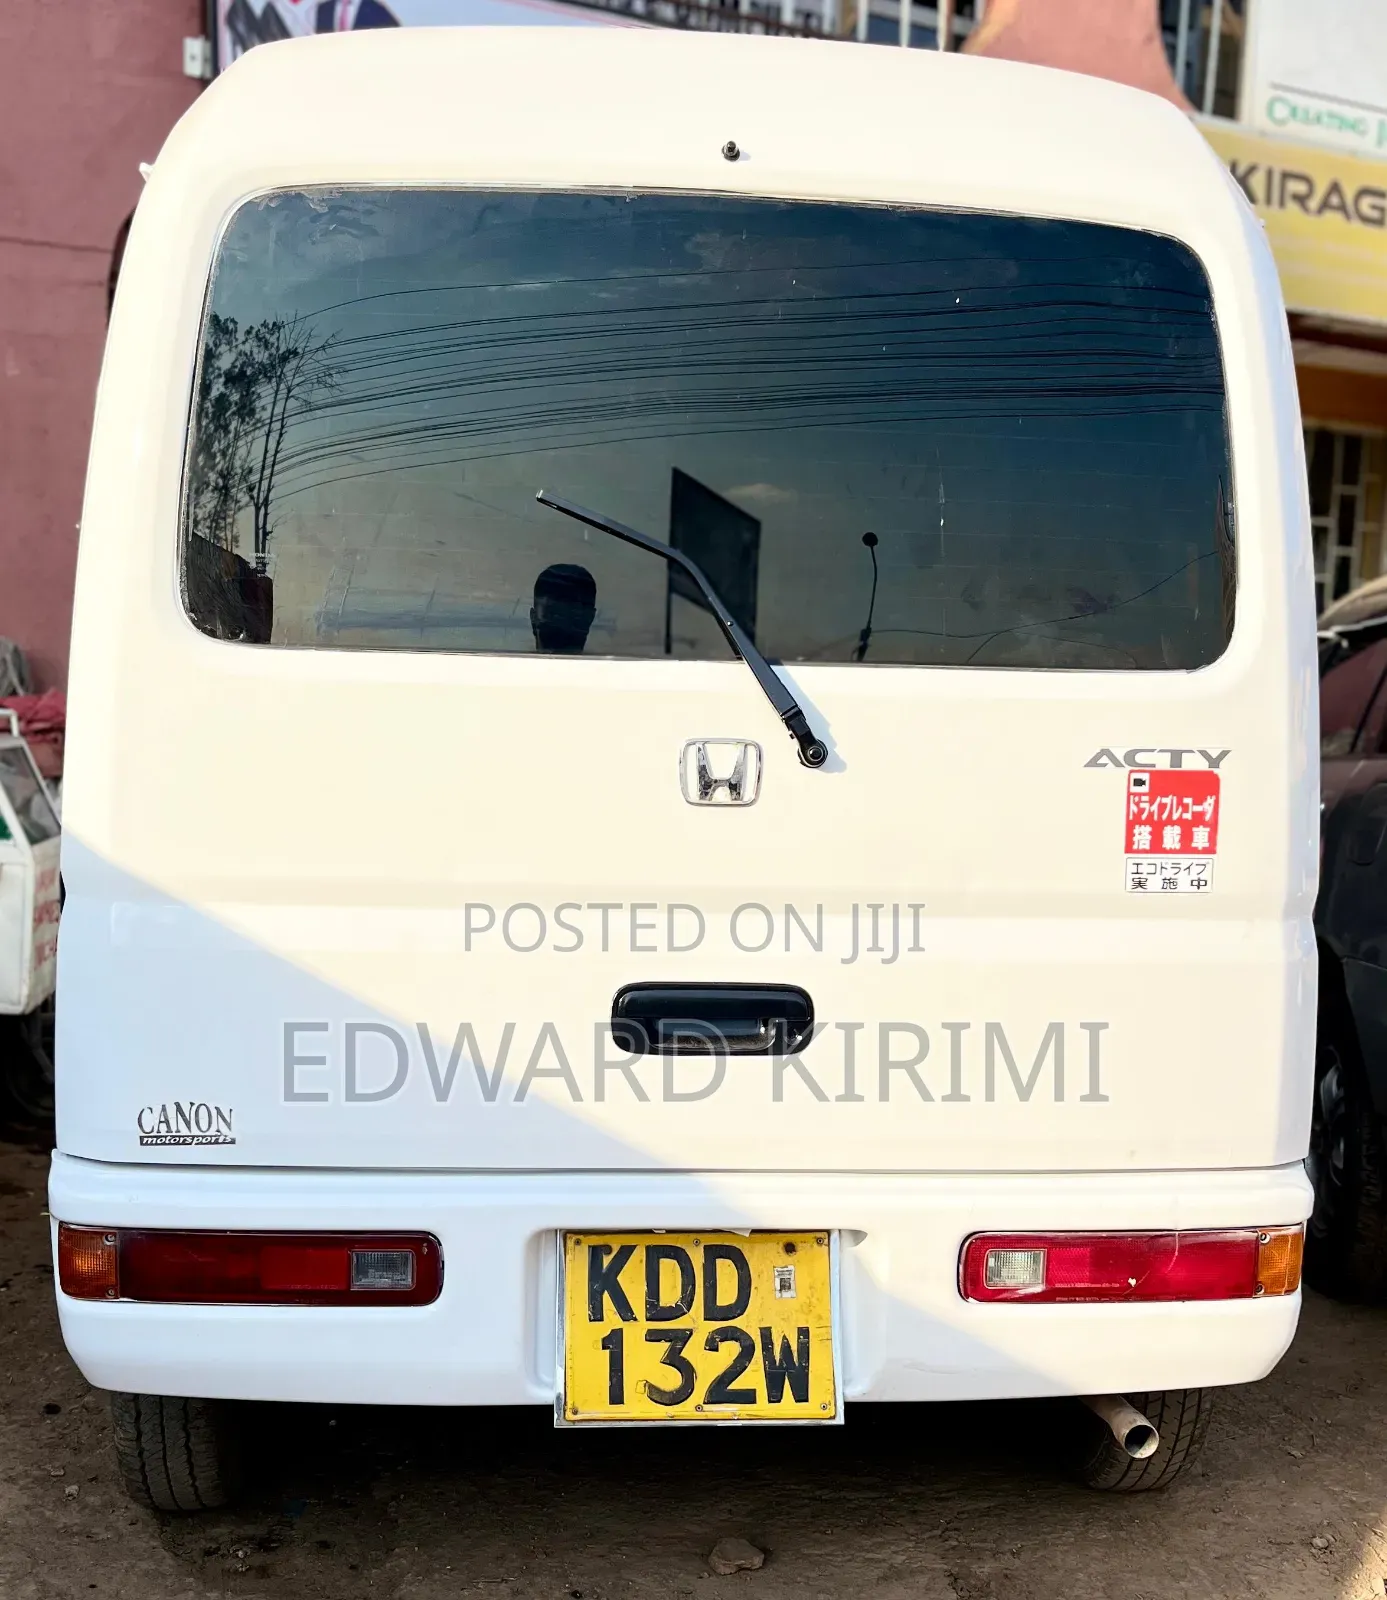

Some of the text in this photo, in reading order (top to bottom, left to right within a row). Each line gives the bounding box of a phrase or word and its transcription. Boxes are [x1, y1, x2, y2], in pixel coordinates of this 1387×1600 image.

[1083, 748, 1232, 769] ACTY
[137, 1101, 233, 1134] CANON
[142, 1134, 232, 1145] motorsports
[587, 1244, 752, 1322] KDD
[601, 1325, 810, 1406] 132W
